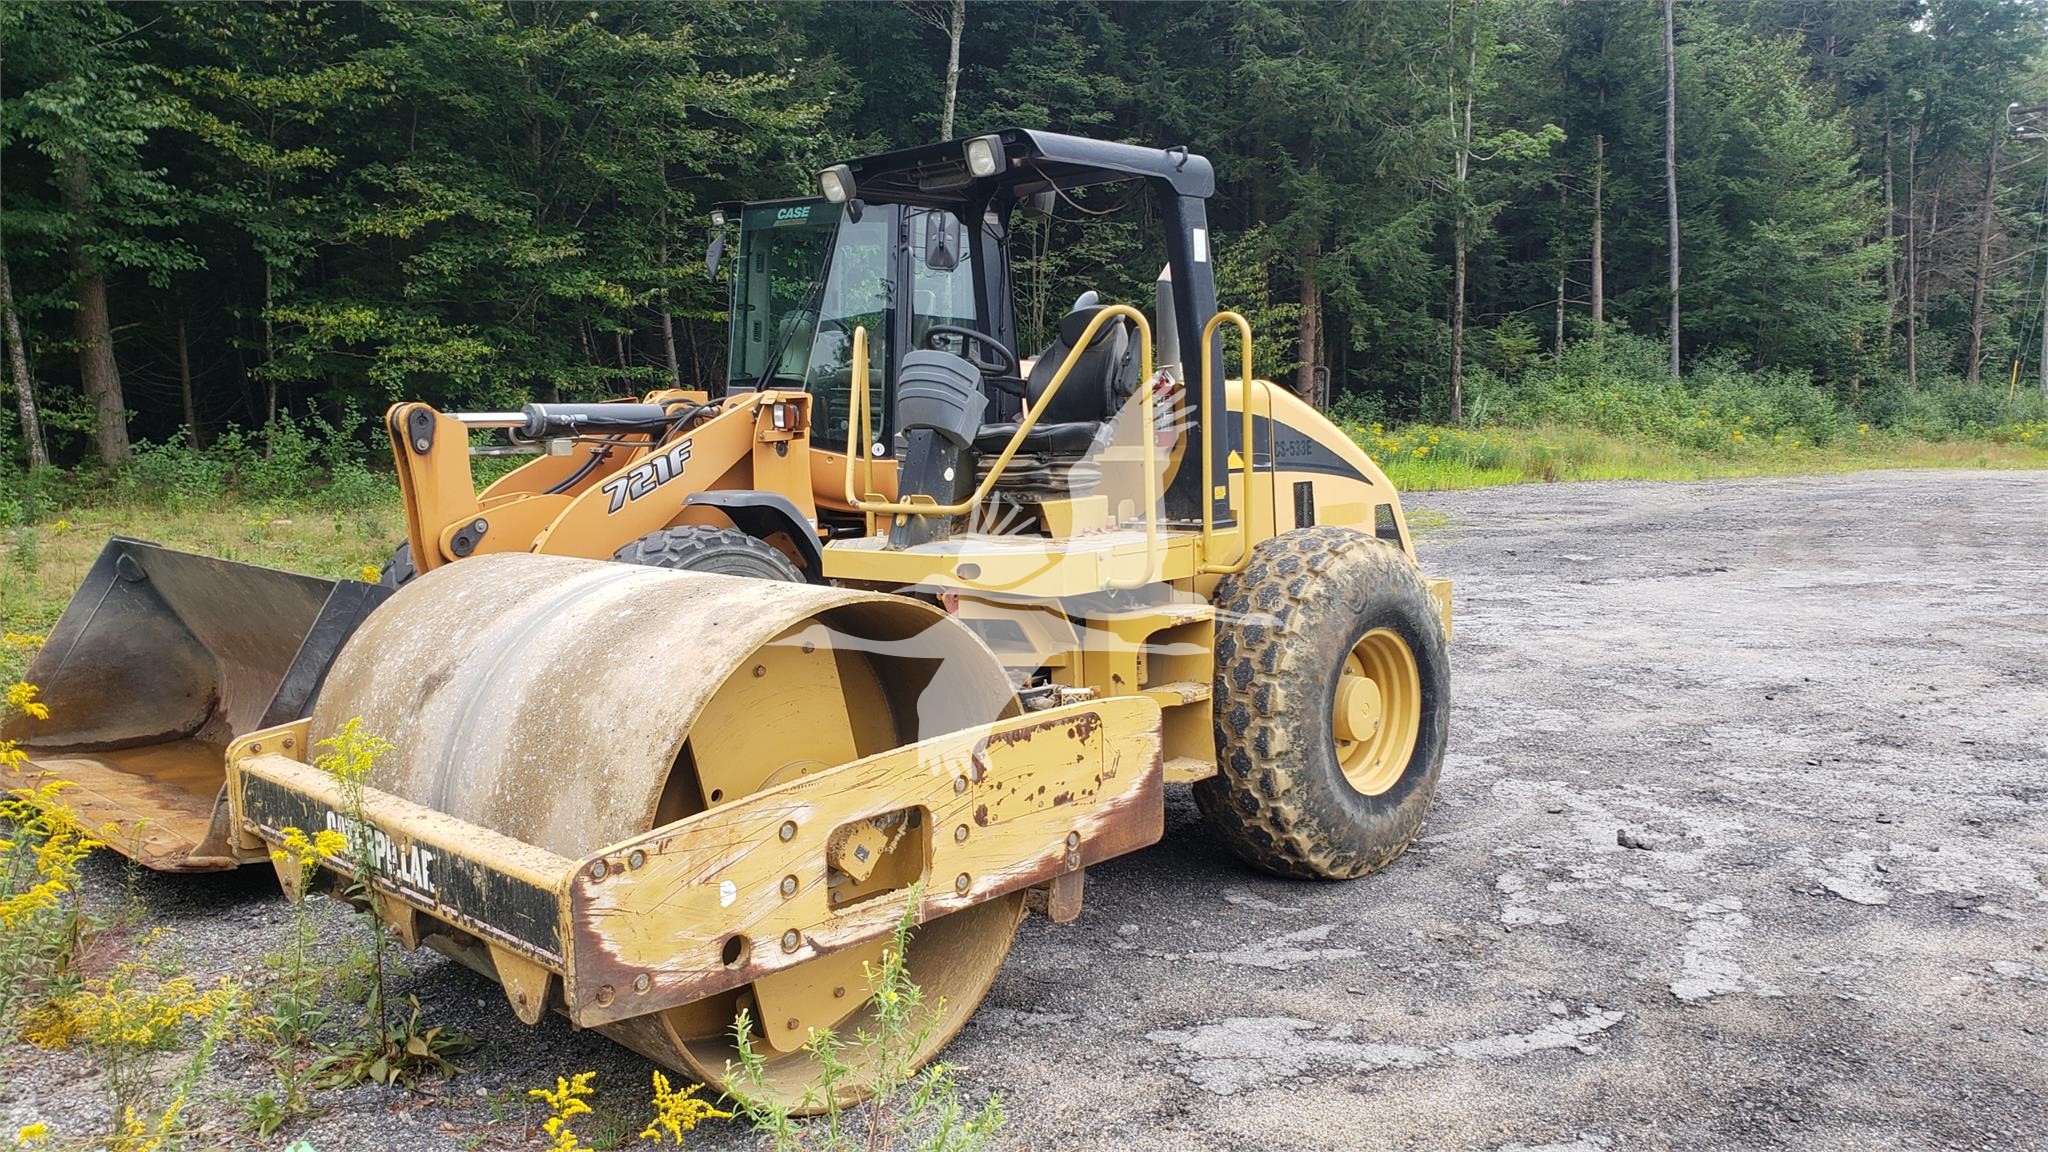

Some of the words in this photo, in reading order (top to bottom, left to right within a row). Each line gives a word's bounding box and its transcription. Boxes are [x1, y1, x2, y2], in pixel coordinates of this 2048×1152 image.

[777, 206, 812, 219] CASE
[1274, 439, 1312, 457] CS-533E
[602, 438, 693, 514] 721F
